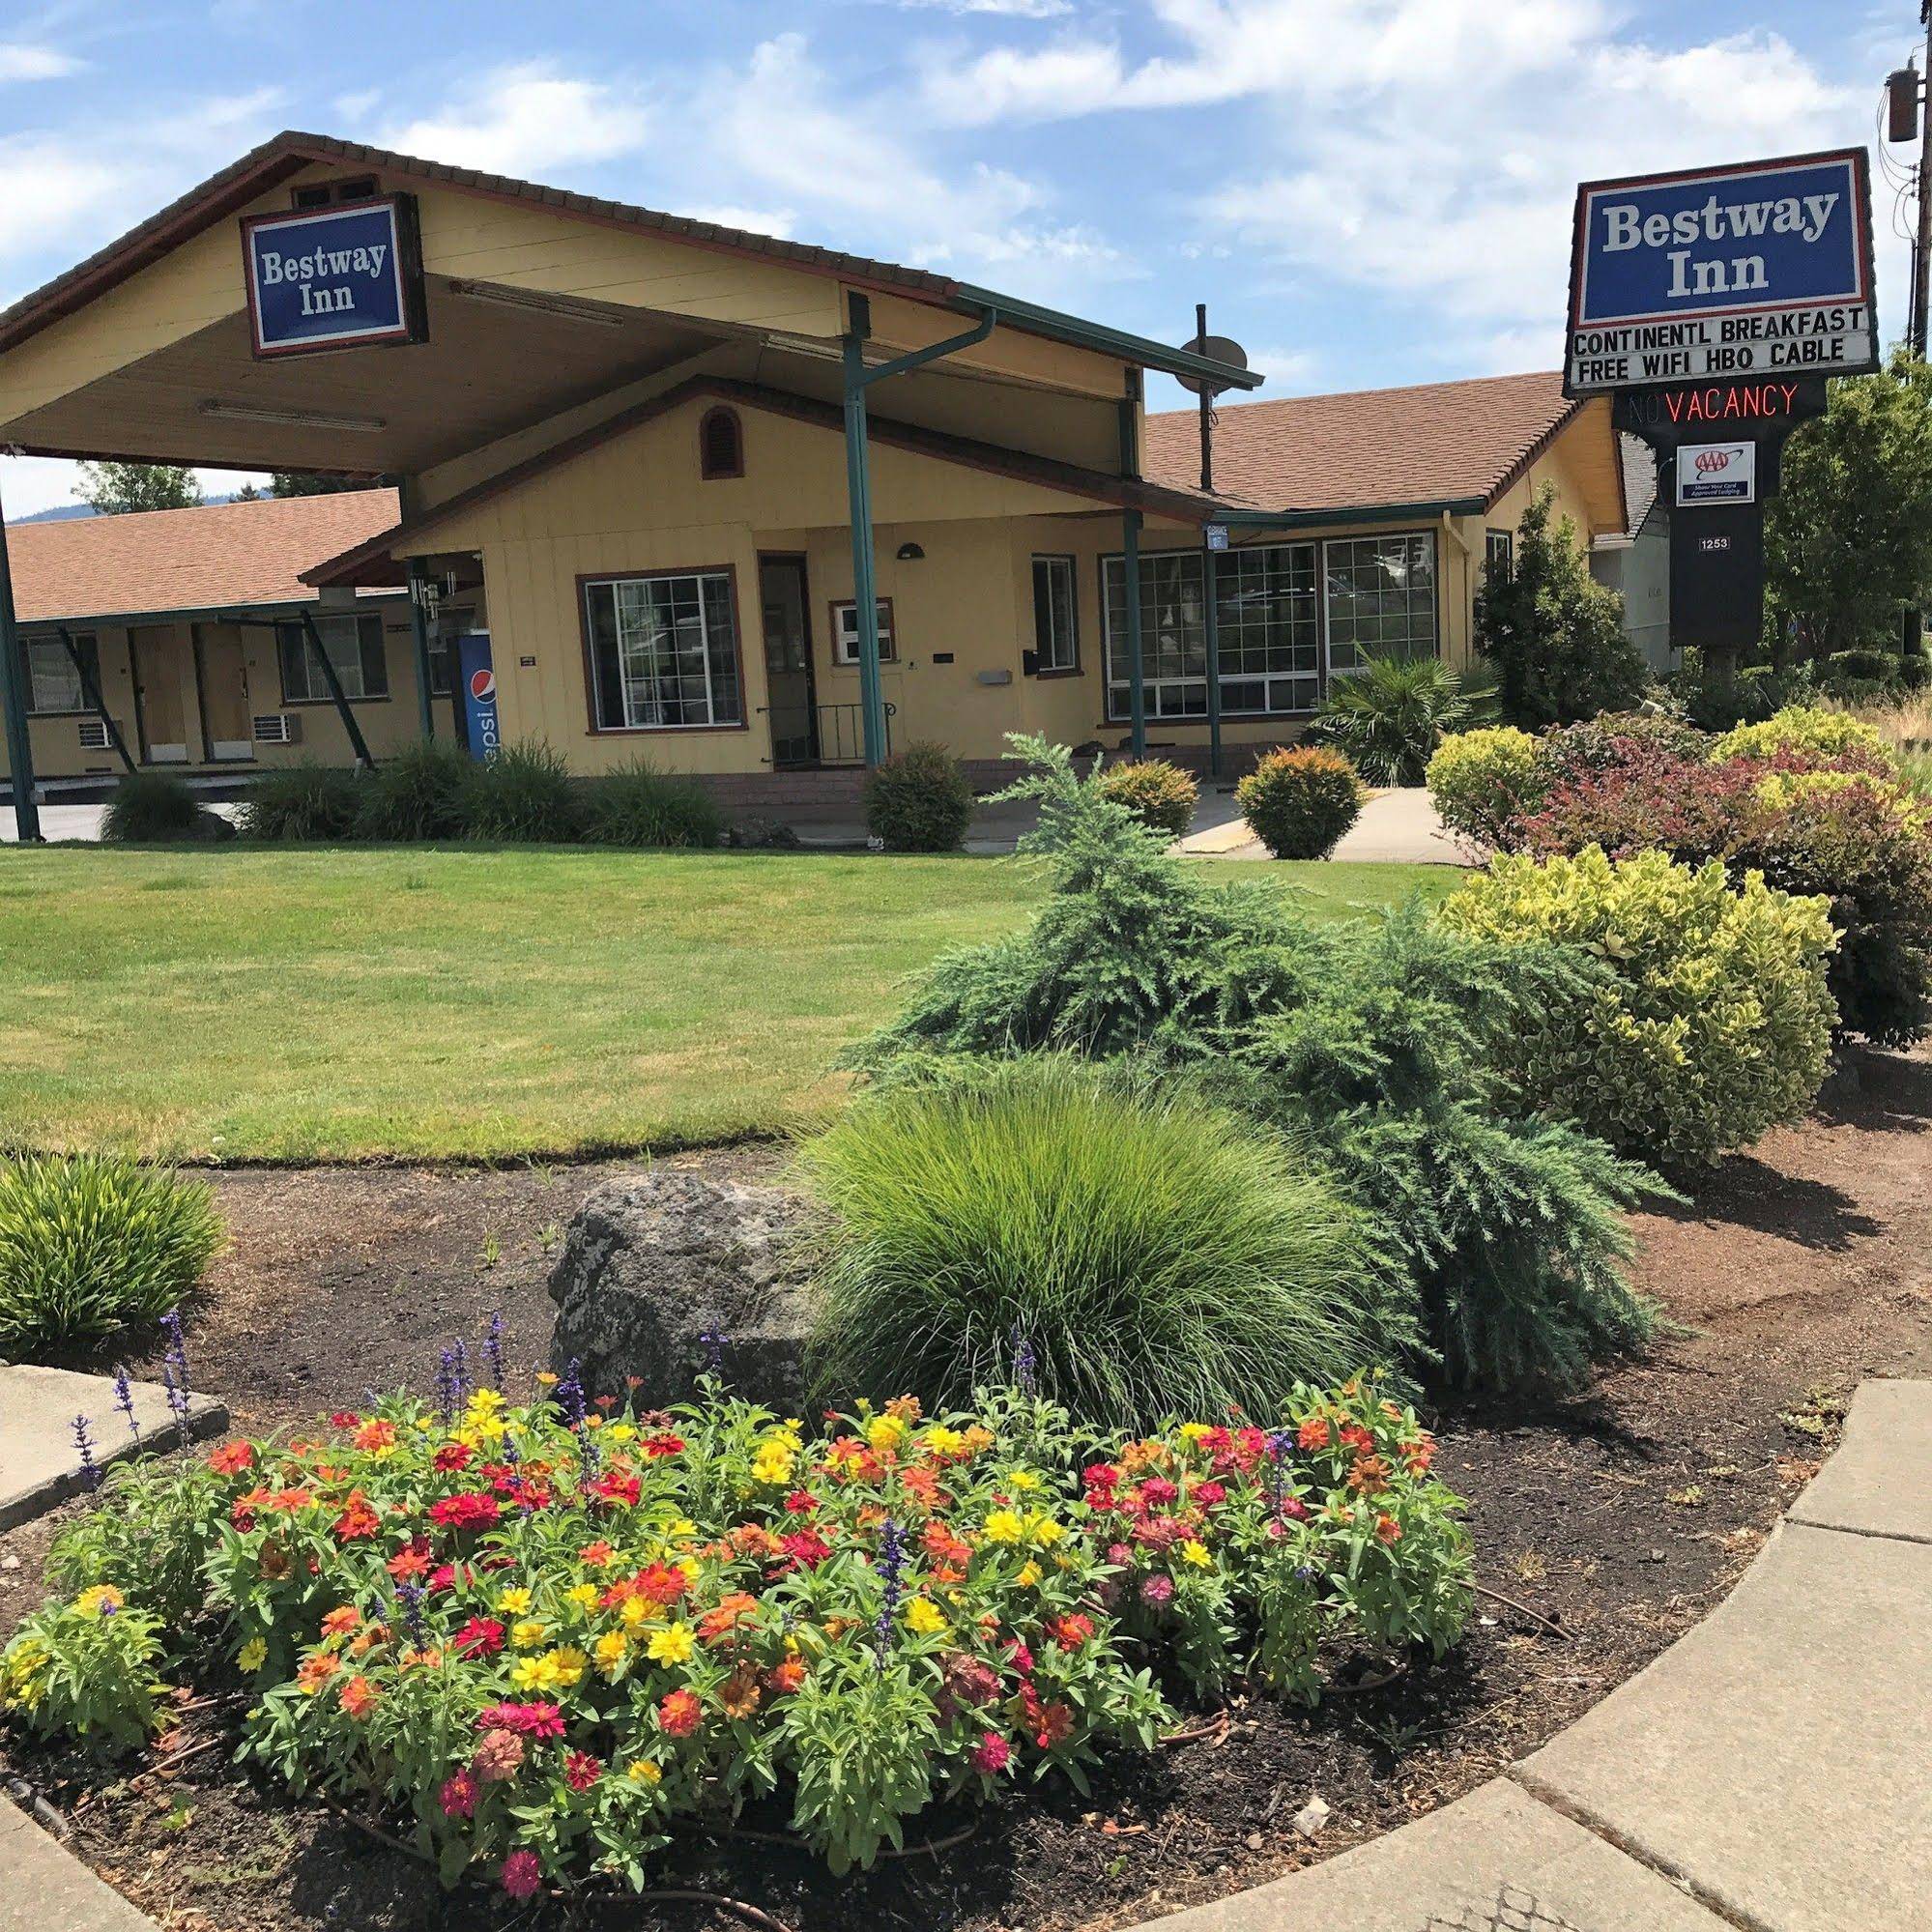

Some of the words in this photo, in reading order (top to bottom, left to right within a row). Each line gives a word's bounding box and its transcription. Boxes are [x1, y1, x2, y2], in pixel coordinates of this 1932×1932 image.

[1602, 193, 1839, 252] Bestway
[261, 244, 387, 285] Bestway
[1666, 249, 1770, 299] Inn
[299, 282, 356, 316] Inn
[1573, 322, 1712, 356] CONTINENTL
[1720, 307, 1863, 342] BREAKFAST
[1578, 358, 1629, 383] FREE
[1643, 351, 1690, 376] WIFI
[1706, 346, 1754, 372] HBO
[1770, 338, 1845, 367] CABLE
[1629, 393, 1659, 424] NO
[1665, 385, 1799, 422] VACANCY
[1699, 451, 1725, 471] AAA
[1701, 538, 1728, 550] 1253
[476, 711, 501, 772] epsi
